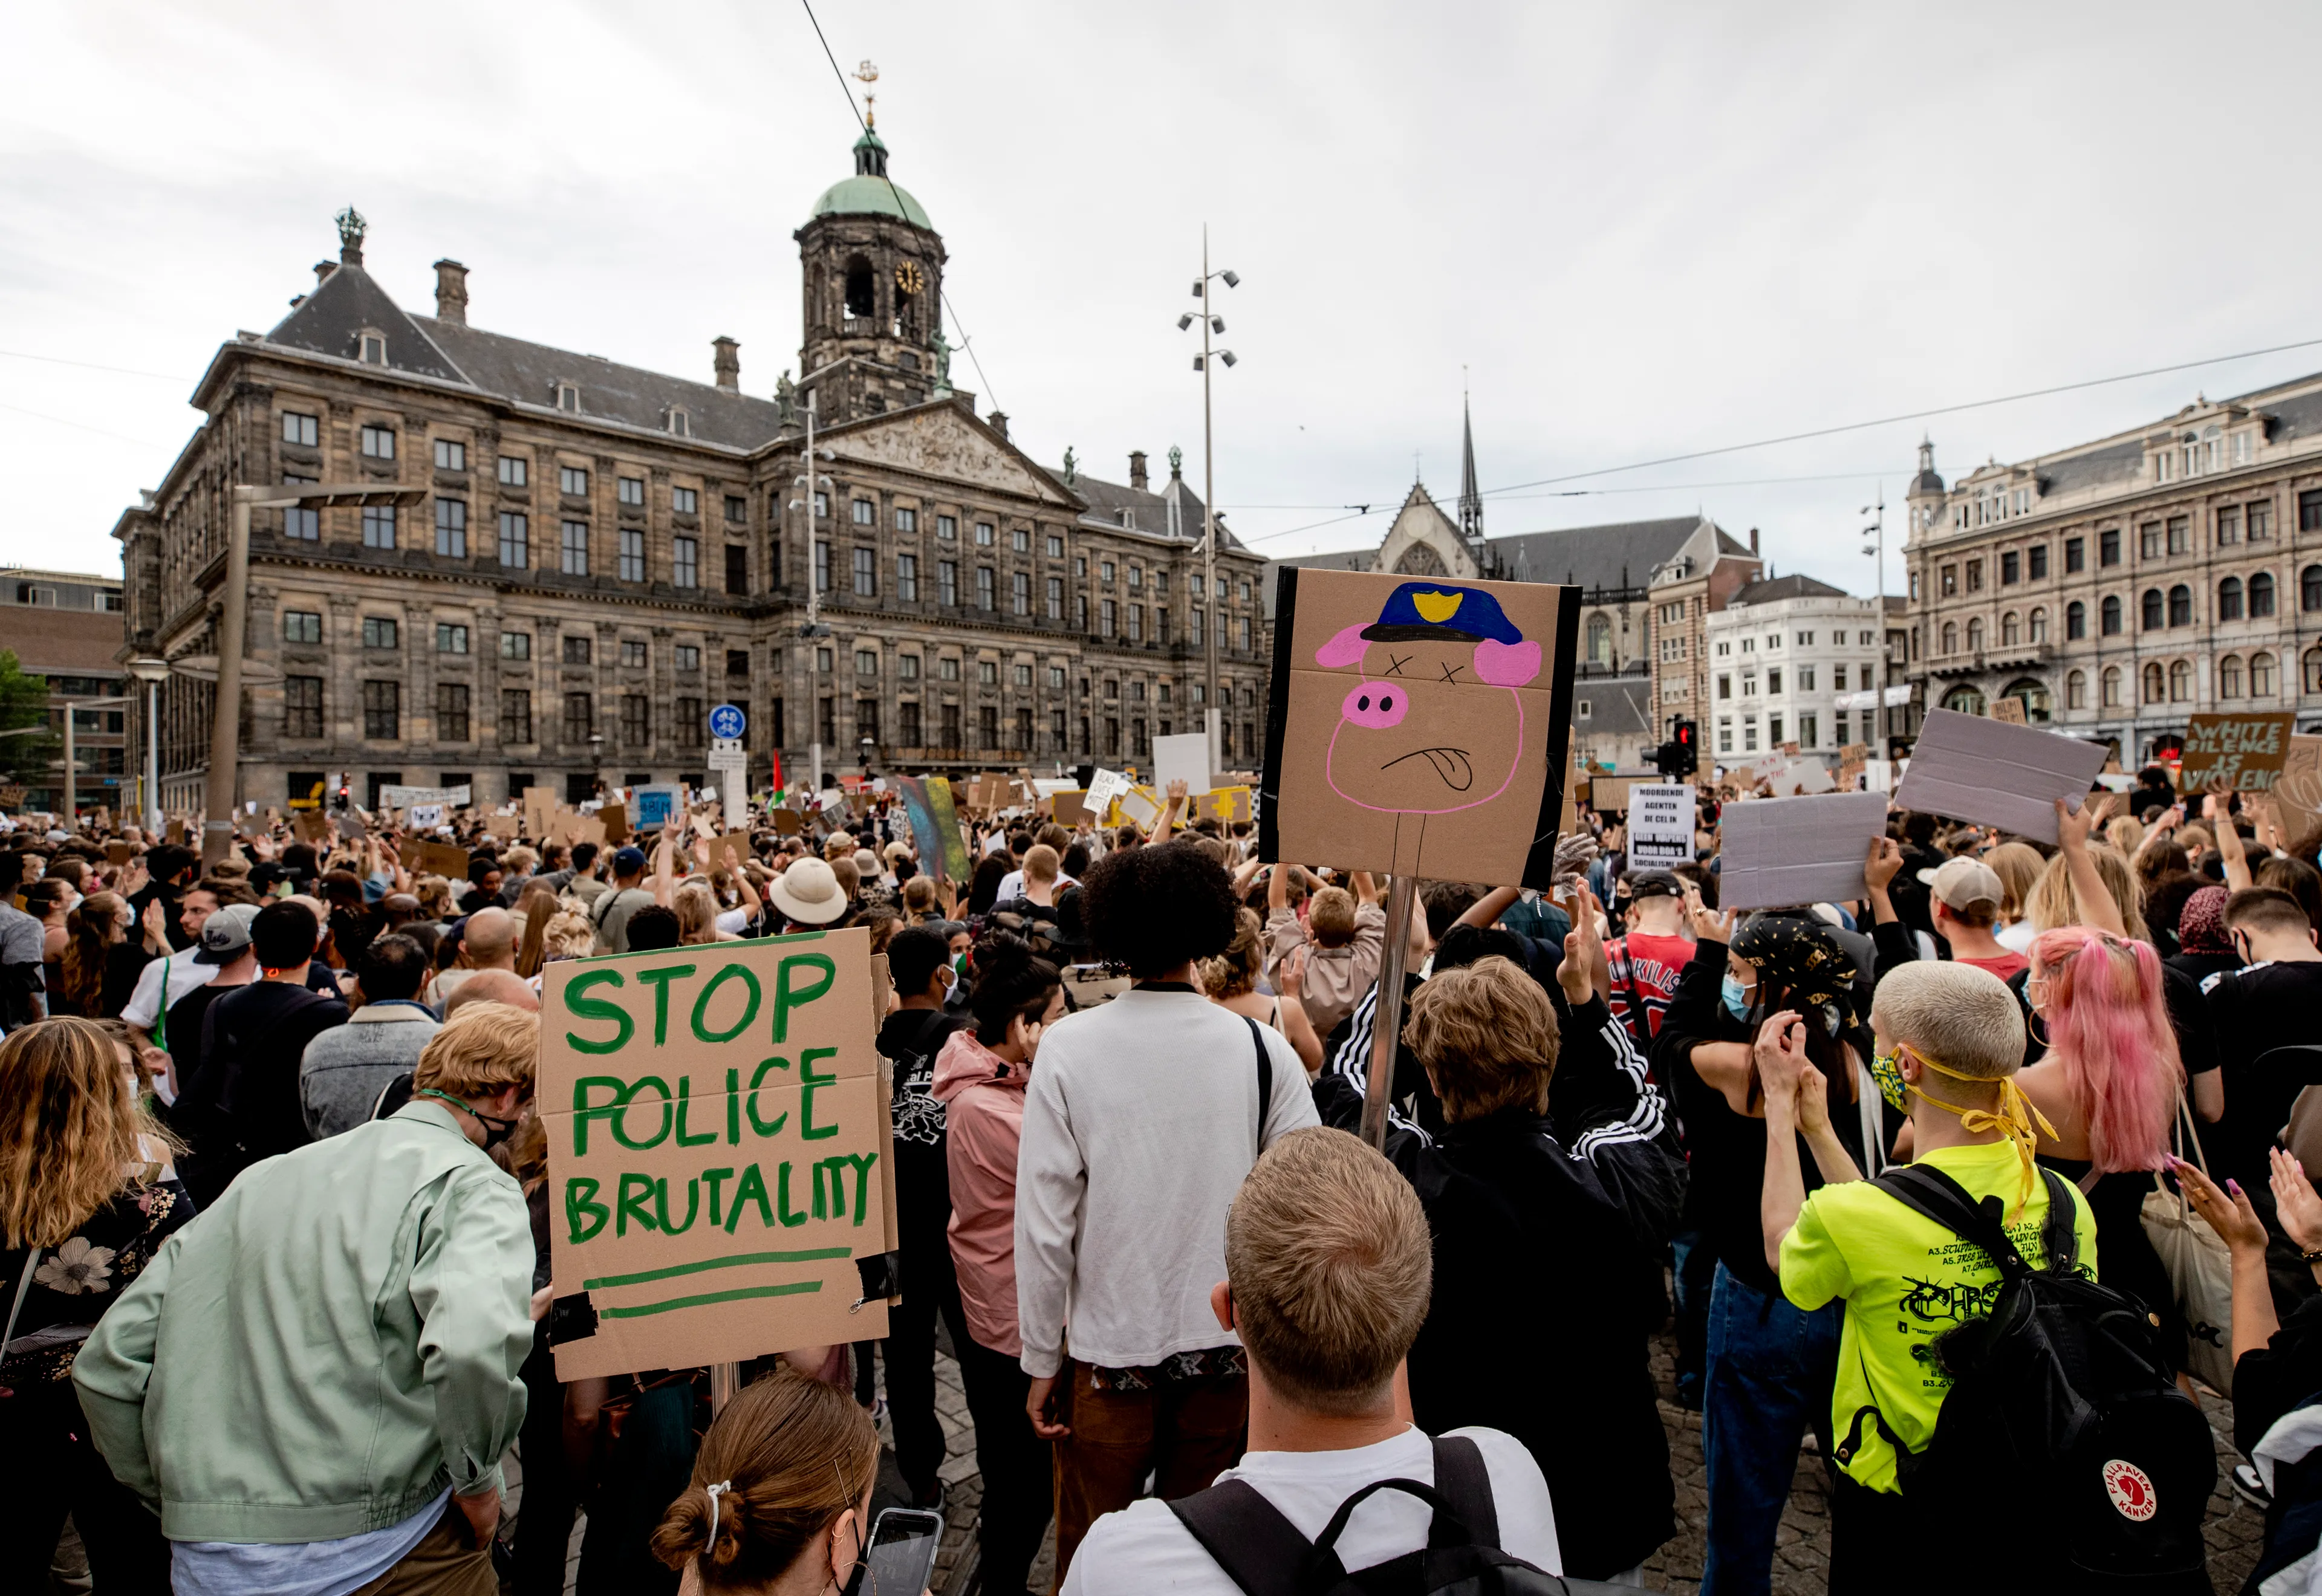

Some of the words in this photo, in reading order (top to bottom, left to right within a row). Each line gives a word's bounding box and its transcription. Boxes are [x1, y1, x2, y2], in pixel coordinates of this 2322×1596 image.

[2193, 721, 2283, 740] WHITE
[2185, 739, 2280, 755] SILENCE
[2210, 755, 2244, 772] IS
[1637, 845, 1659, 855] VOOR
[564, 953, 836, 1054] STOP
[573, 1046, 839, 1157] POLICE
[565, 1152, 879, 1245] BRUTALITY
